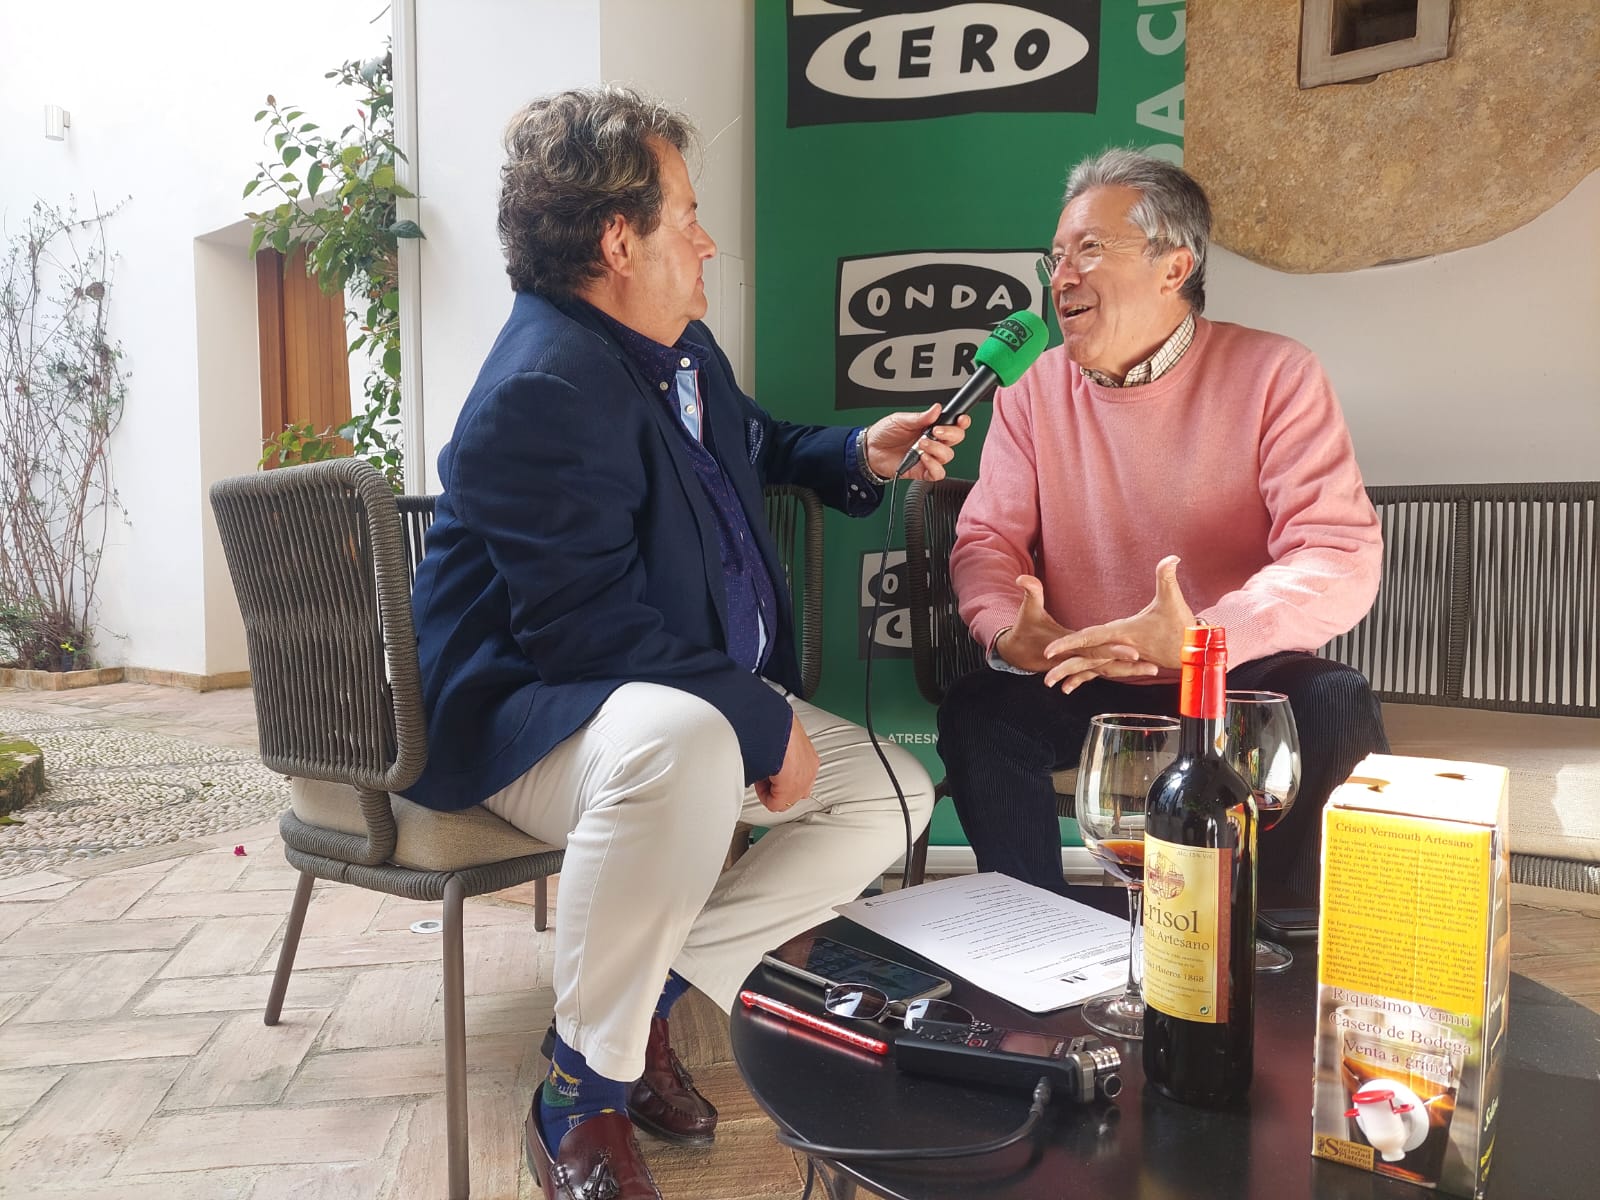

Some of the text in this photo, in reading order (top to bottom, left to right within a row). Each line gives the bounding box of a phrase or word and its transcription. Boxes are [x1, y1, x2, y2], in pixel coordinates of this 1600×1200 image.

[843, 23, 1051, 81] CERO
[866, 284, 1014, 317] ONDA
[873, 342, 979, 380] CER
[1335, 822, 1474, 849] Crisol Vermouth Artesano
[1157, 930, 1210, 951] Artesano
[1333, 987, 1412, 1016] Riquísimo
[1418, 1004, 1471, 1028] Vermú
[1330, 1011, 1472, 1056] Casero de Bodega
[1344, 1040, 1386, 1061] Venta
[1391, 1055, 1400, 1064] a
